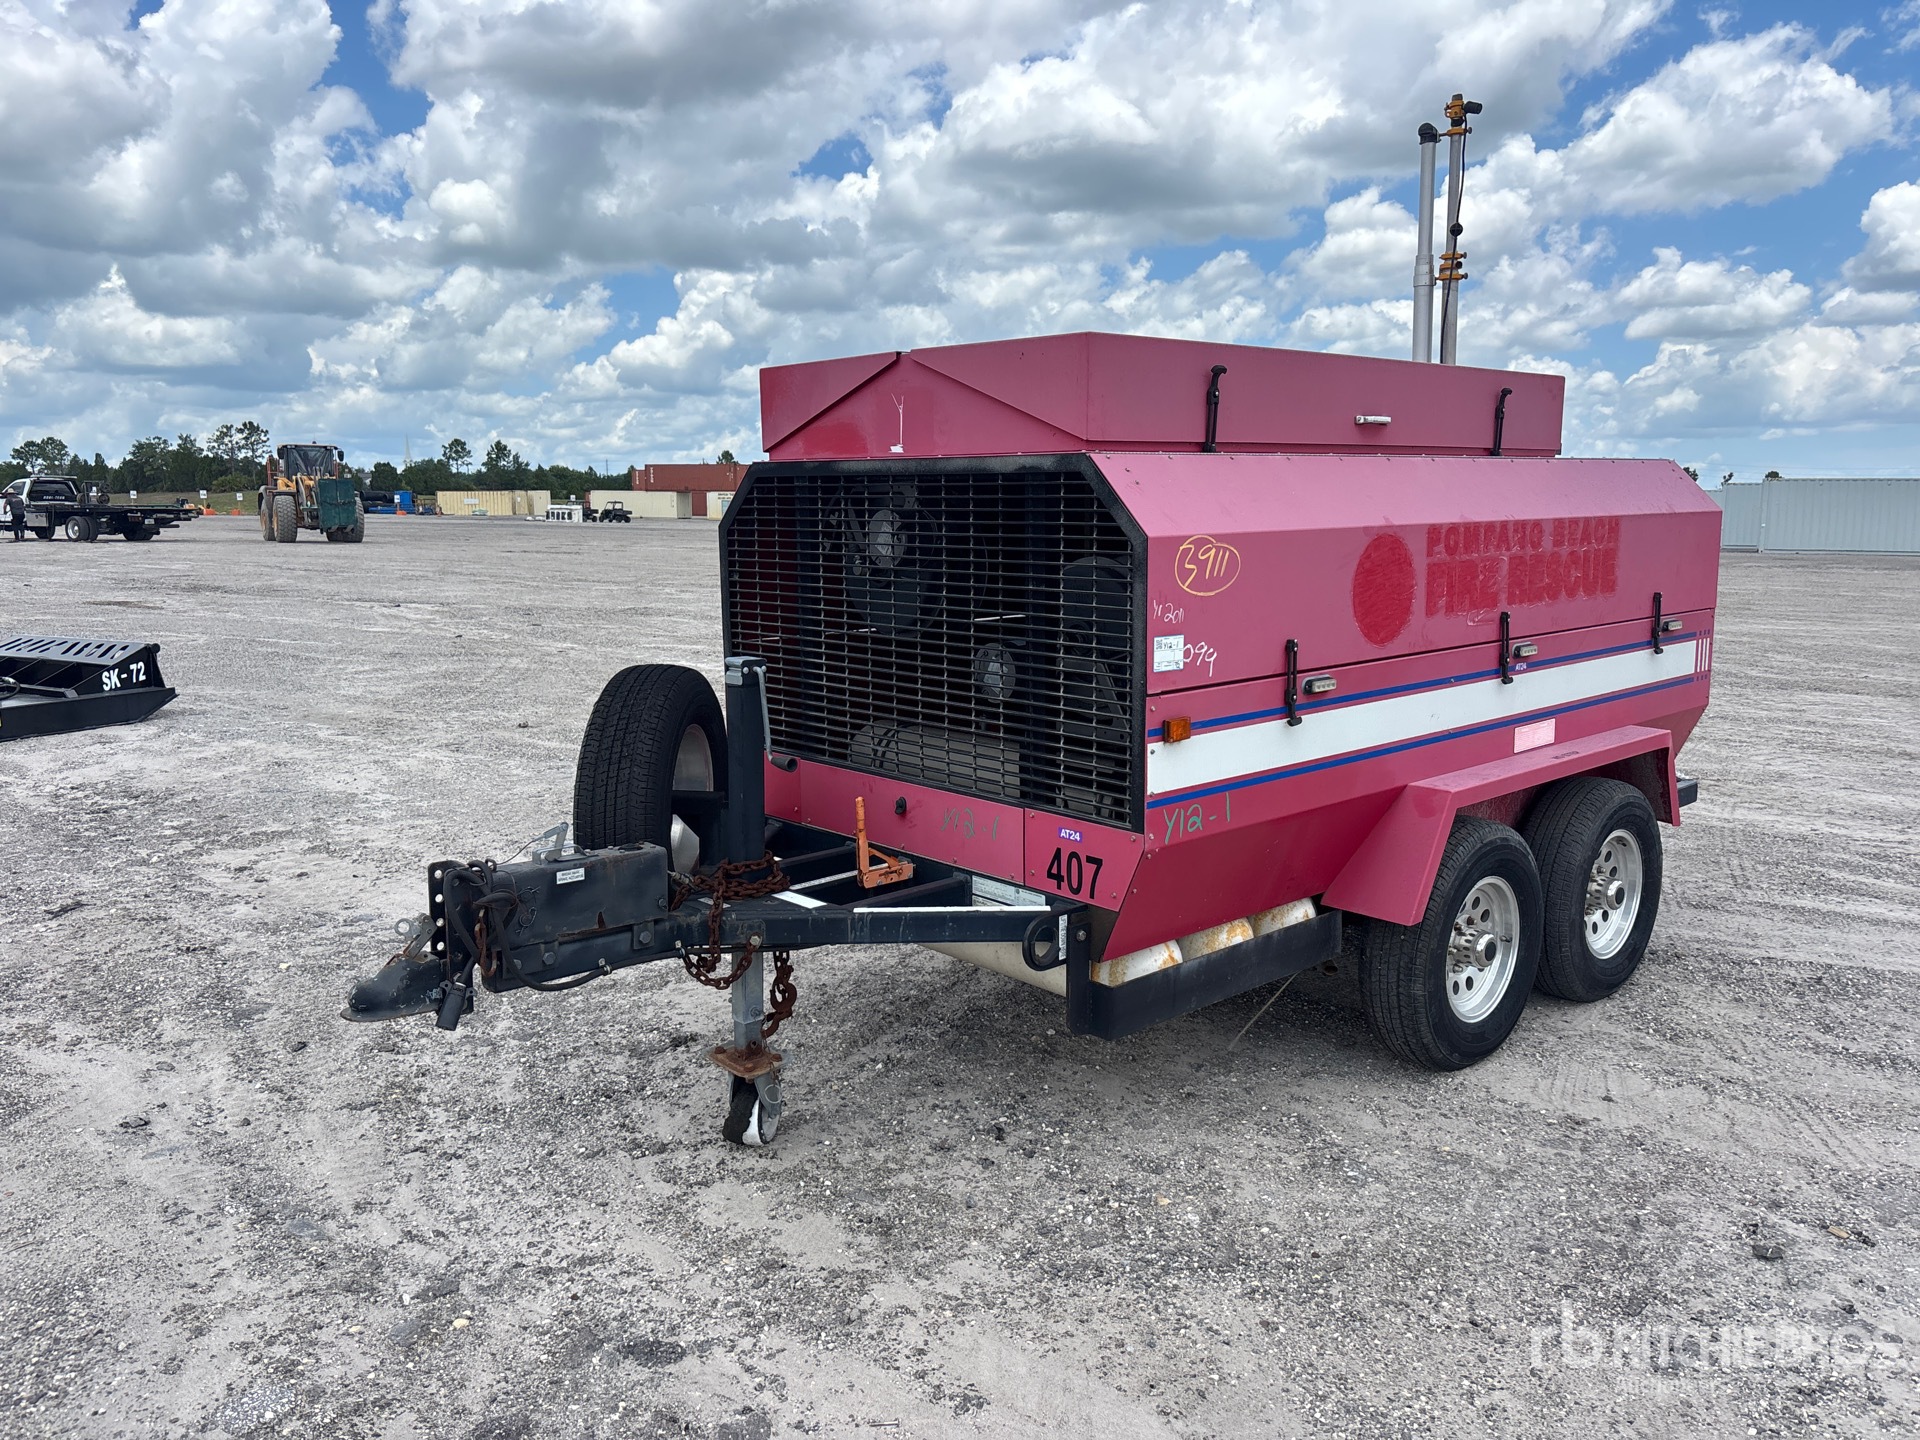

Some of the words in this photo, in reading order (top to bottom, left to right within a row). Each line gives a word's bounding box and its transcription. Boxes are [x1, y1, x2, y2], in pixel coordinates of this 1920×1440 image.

[1508, 548, 1617, 606] RESCUE
[1060, 827, 1081, 841] AT24
[1163, 792, 1230, 844] Y12-1
[1046, 847, 1103, 899] 407
